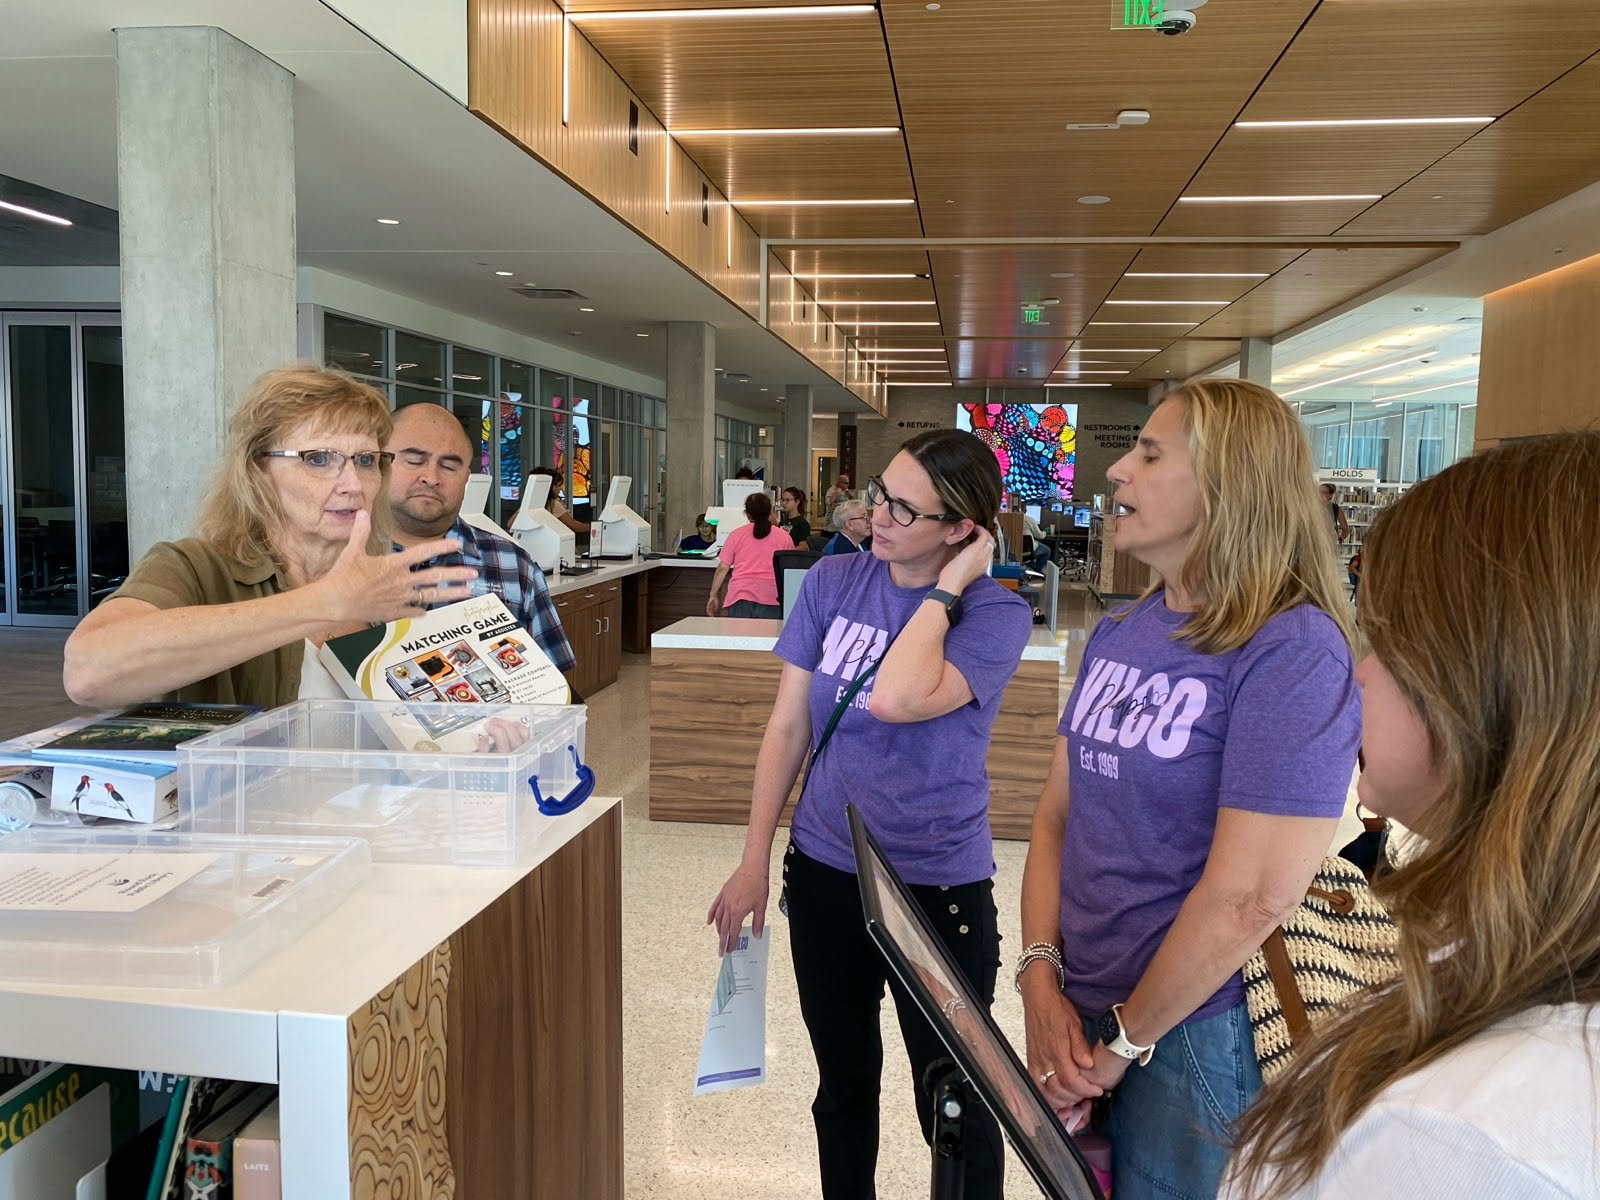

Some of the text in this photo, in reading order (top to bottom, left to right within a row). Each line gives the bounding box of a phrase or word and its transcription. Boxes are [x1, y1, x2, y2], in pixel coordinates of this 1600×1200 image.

[906, 421, 941, 429] RETURNS
[1100, 441, 1131, 449] ROOMS
[1332, 470, 1364, 478] HOLDS
[400, 612, 510, 654] MATCHING GAME
[1080, 745, 1119, 780] Est. 1969
